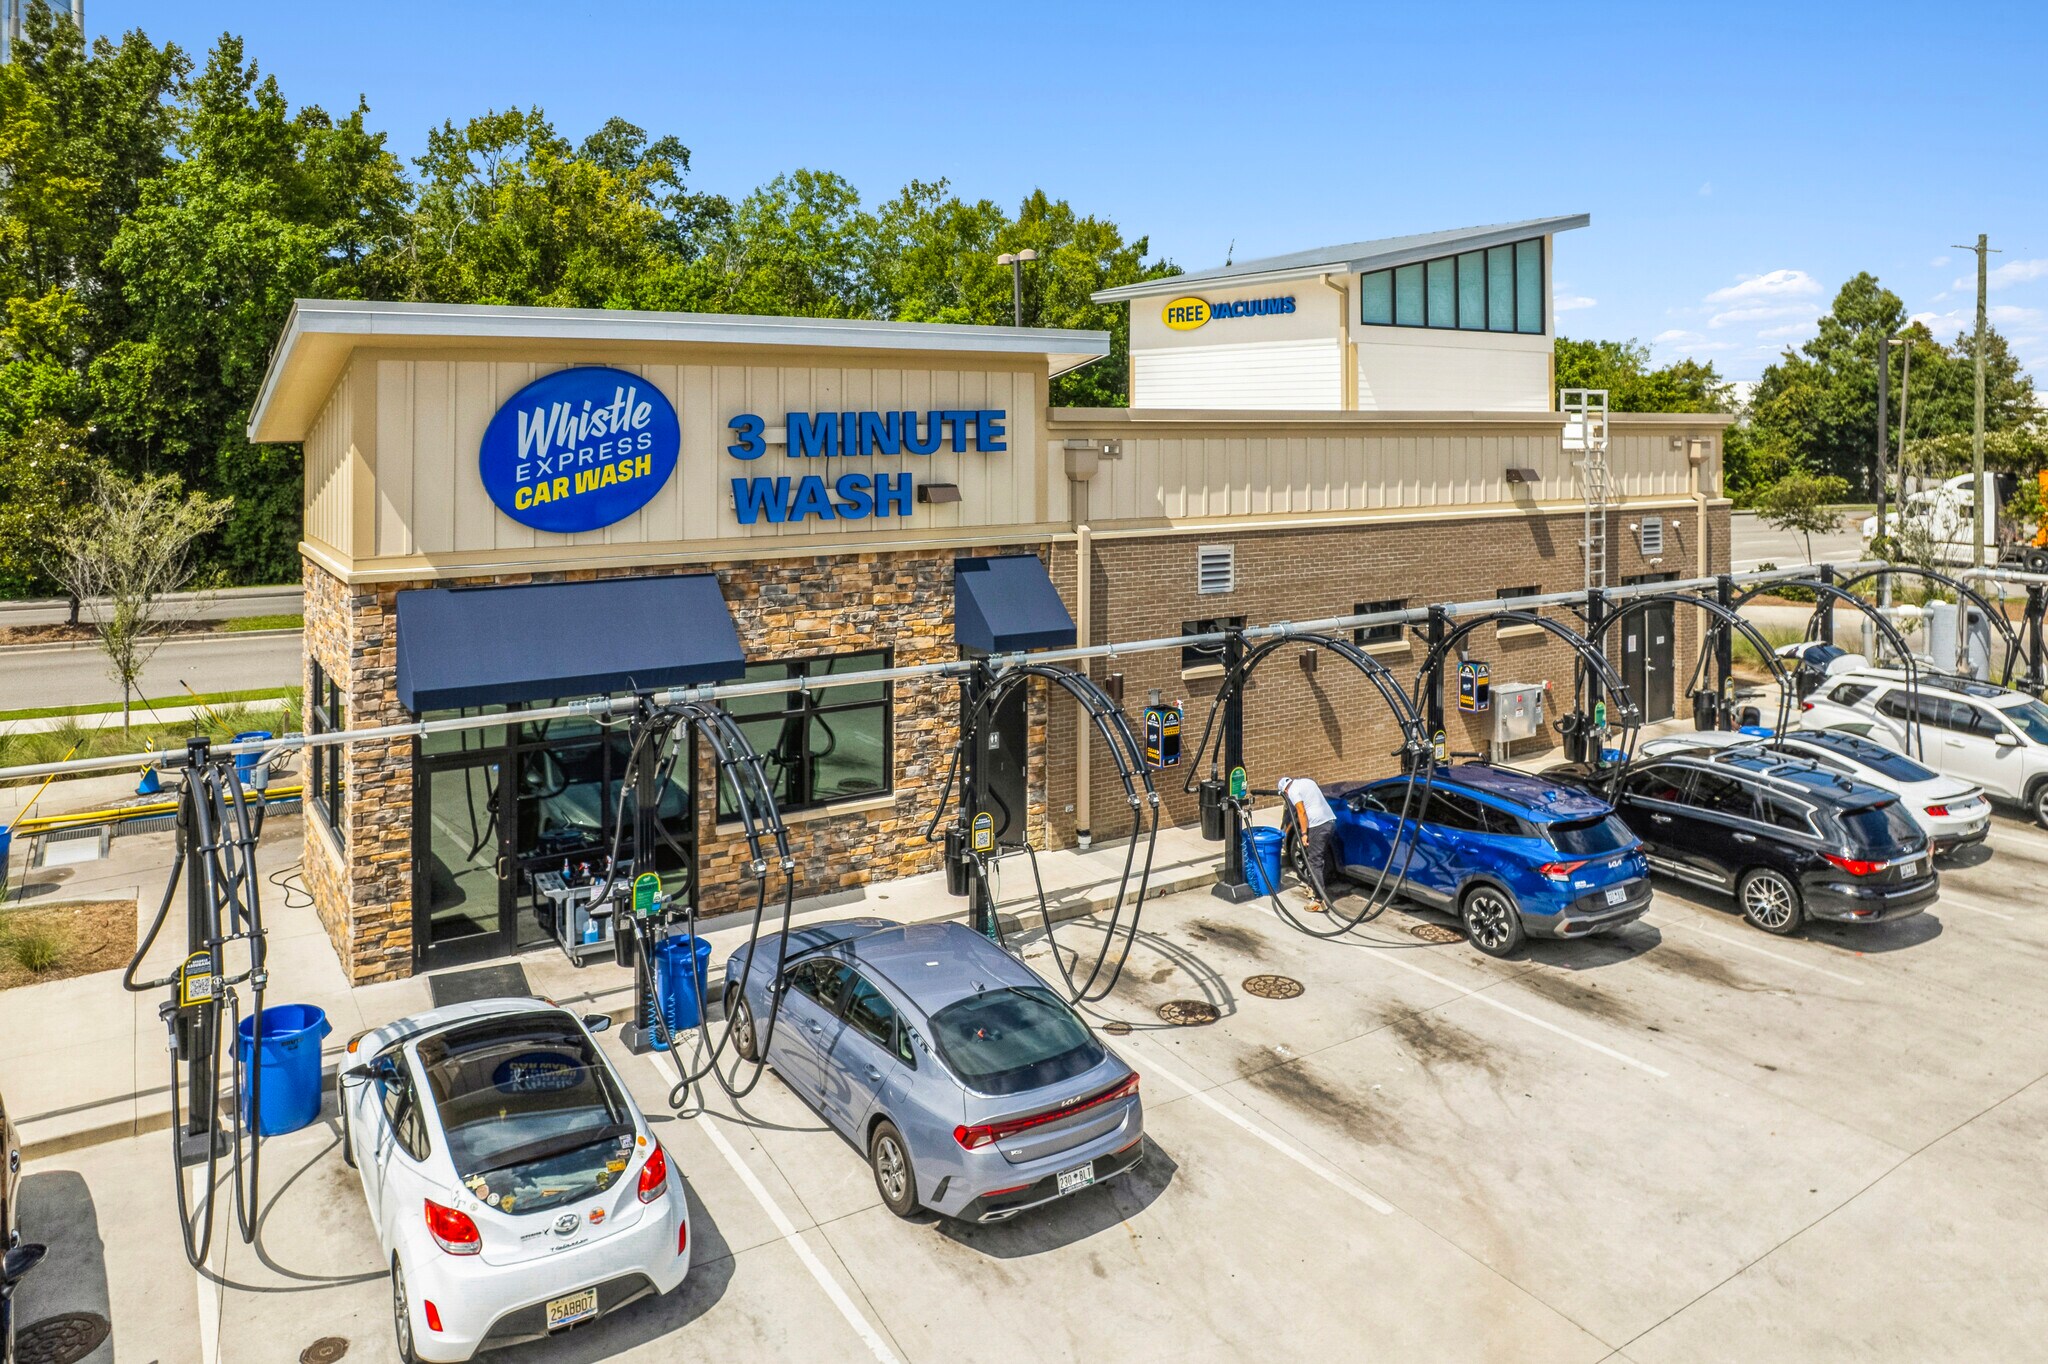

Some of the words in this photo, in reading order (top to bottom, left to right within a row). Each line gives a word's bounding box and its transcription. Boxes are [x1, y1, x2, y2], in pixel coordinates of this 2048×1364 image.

[1168, 305, 1203, 323] FREE
[1210, 297, 1296, 319] VACUUMS
[518, 386, 652, 459] Whistle
[727, 414, 766, 460] 3
[786, 410, 1007, 458] MINUTE
[514, 476, 570, 511] CAR
[574, 453, 652, 495] WASH
[516, 432, 652, 482] EXPRESS
[731, 472, 912, 525] WASH
